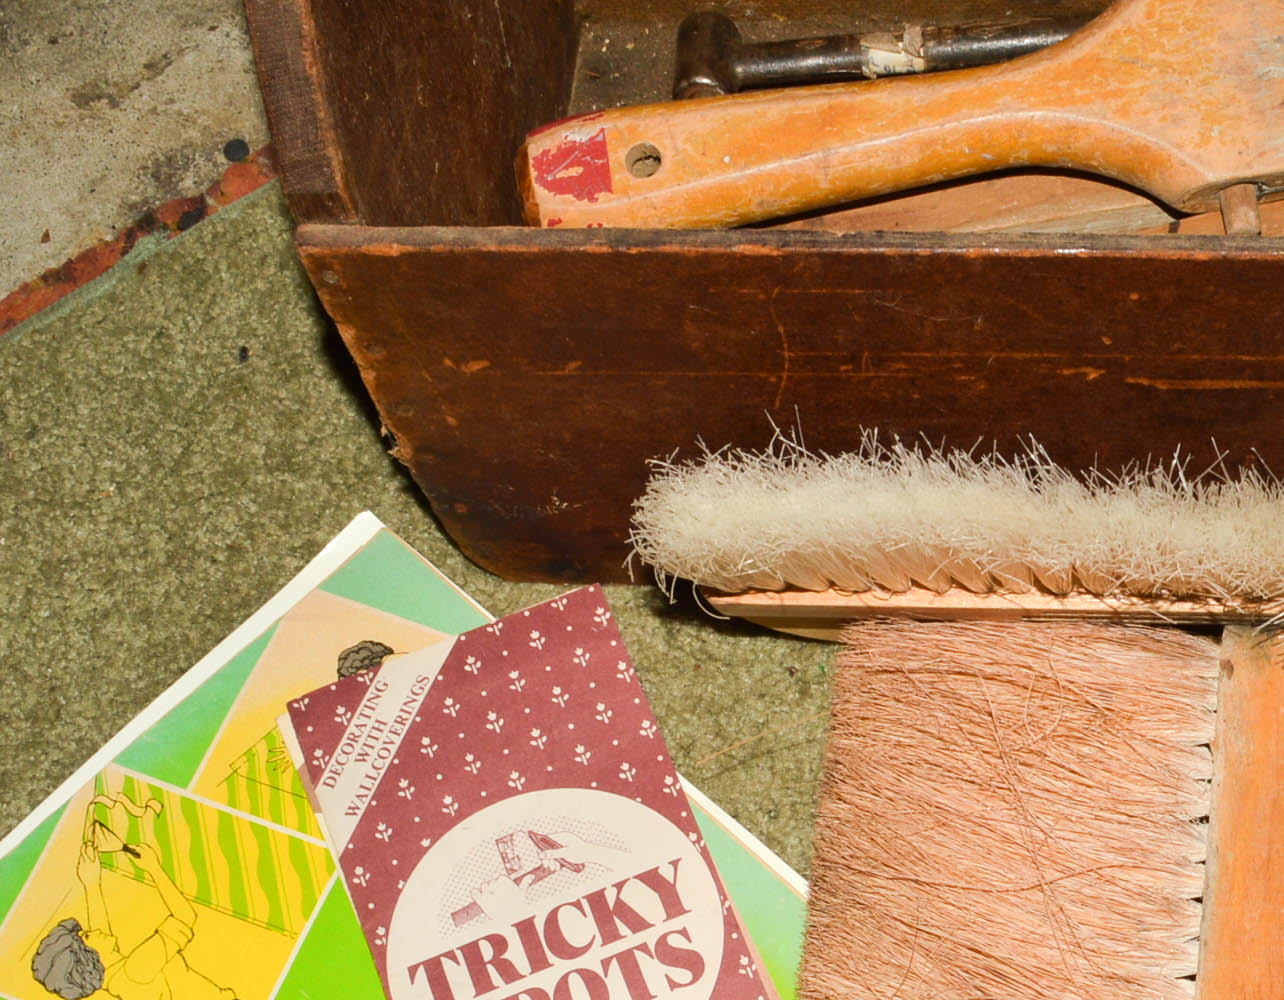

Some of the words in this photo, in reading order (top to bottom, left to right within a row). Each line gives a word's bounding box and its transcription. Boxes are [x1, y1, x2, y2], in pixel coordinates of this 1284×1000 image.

[322, 680, 389, 789] DECORATING
[344, 674, 430, 817] WALLCOVERINGS
[354, 718, 388, 764] WITH
